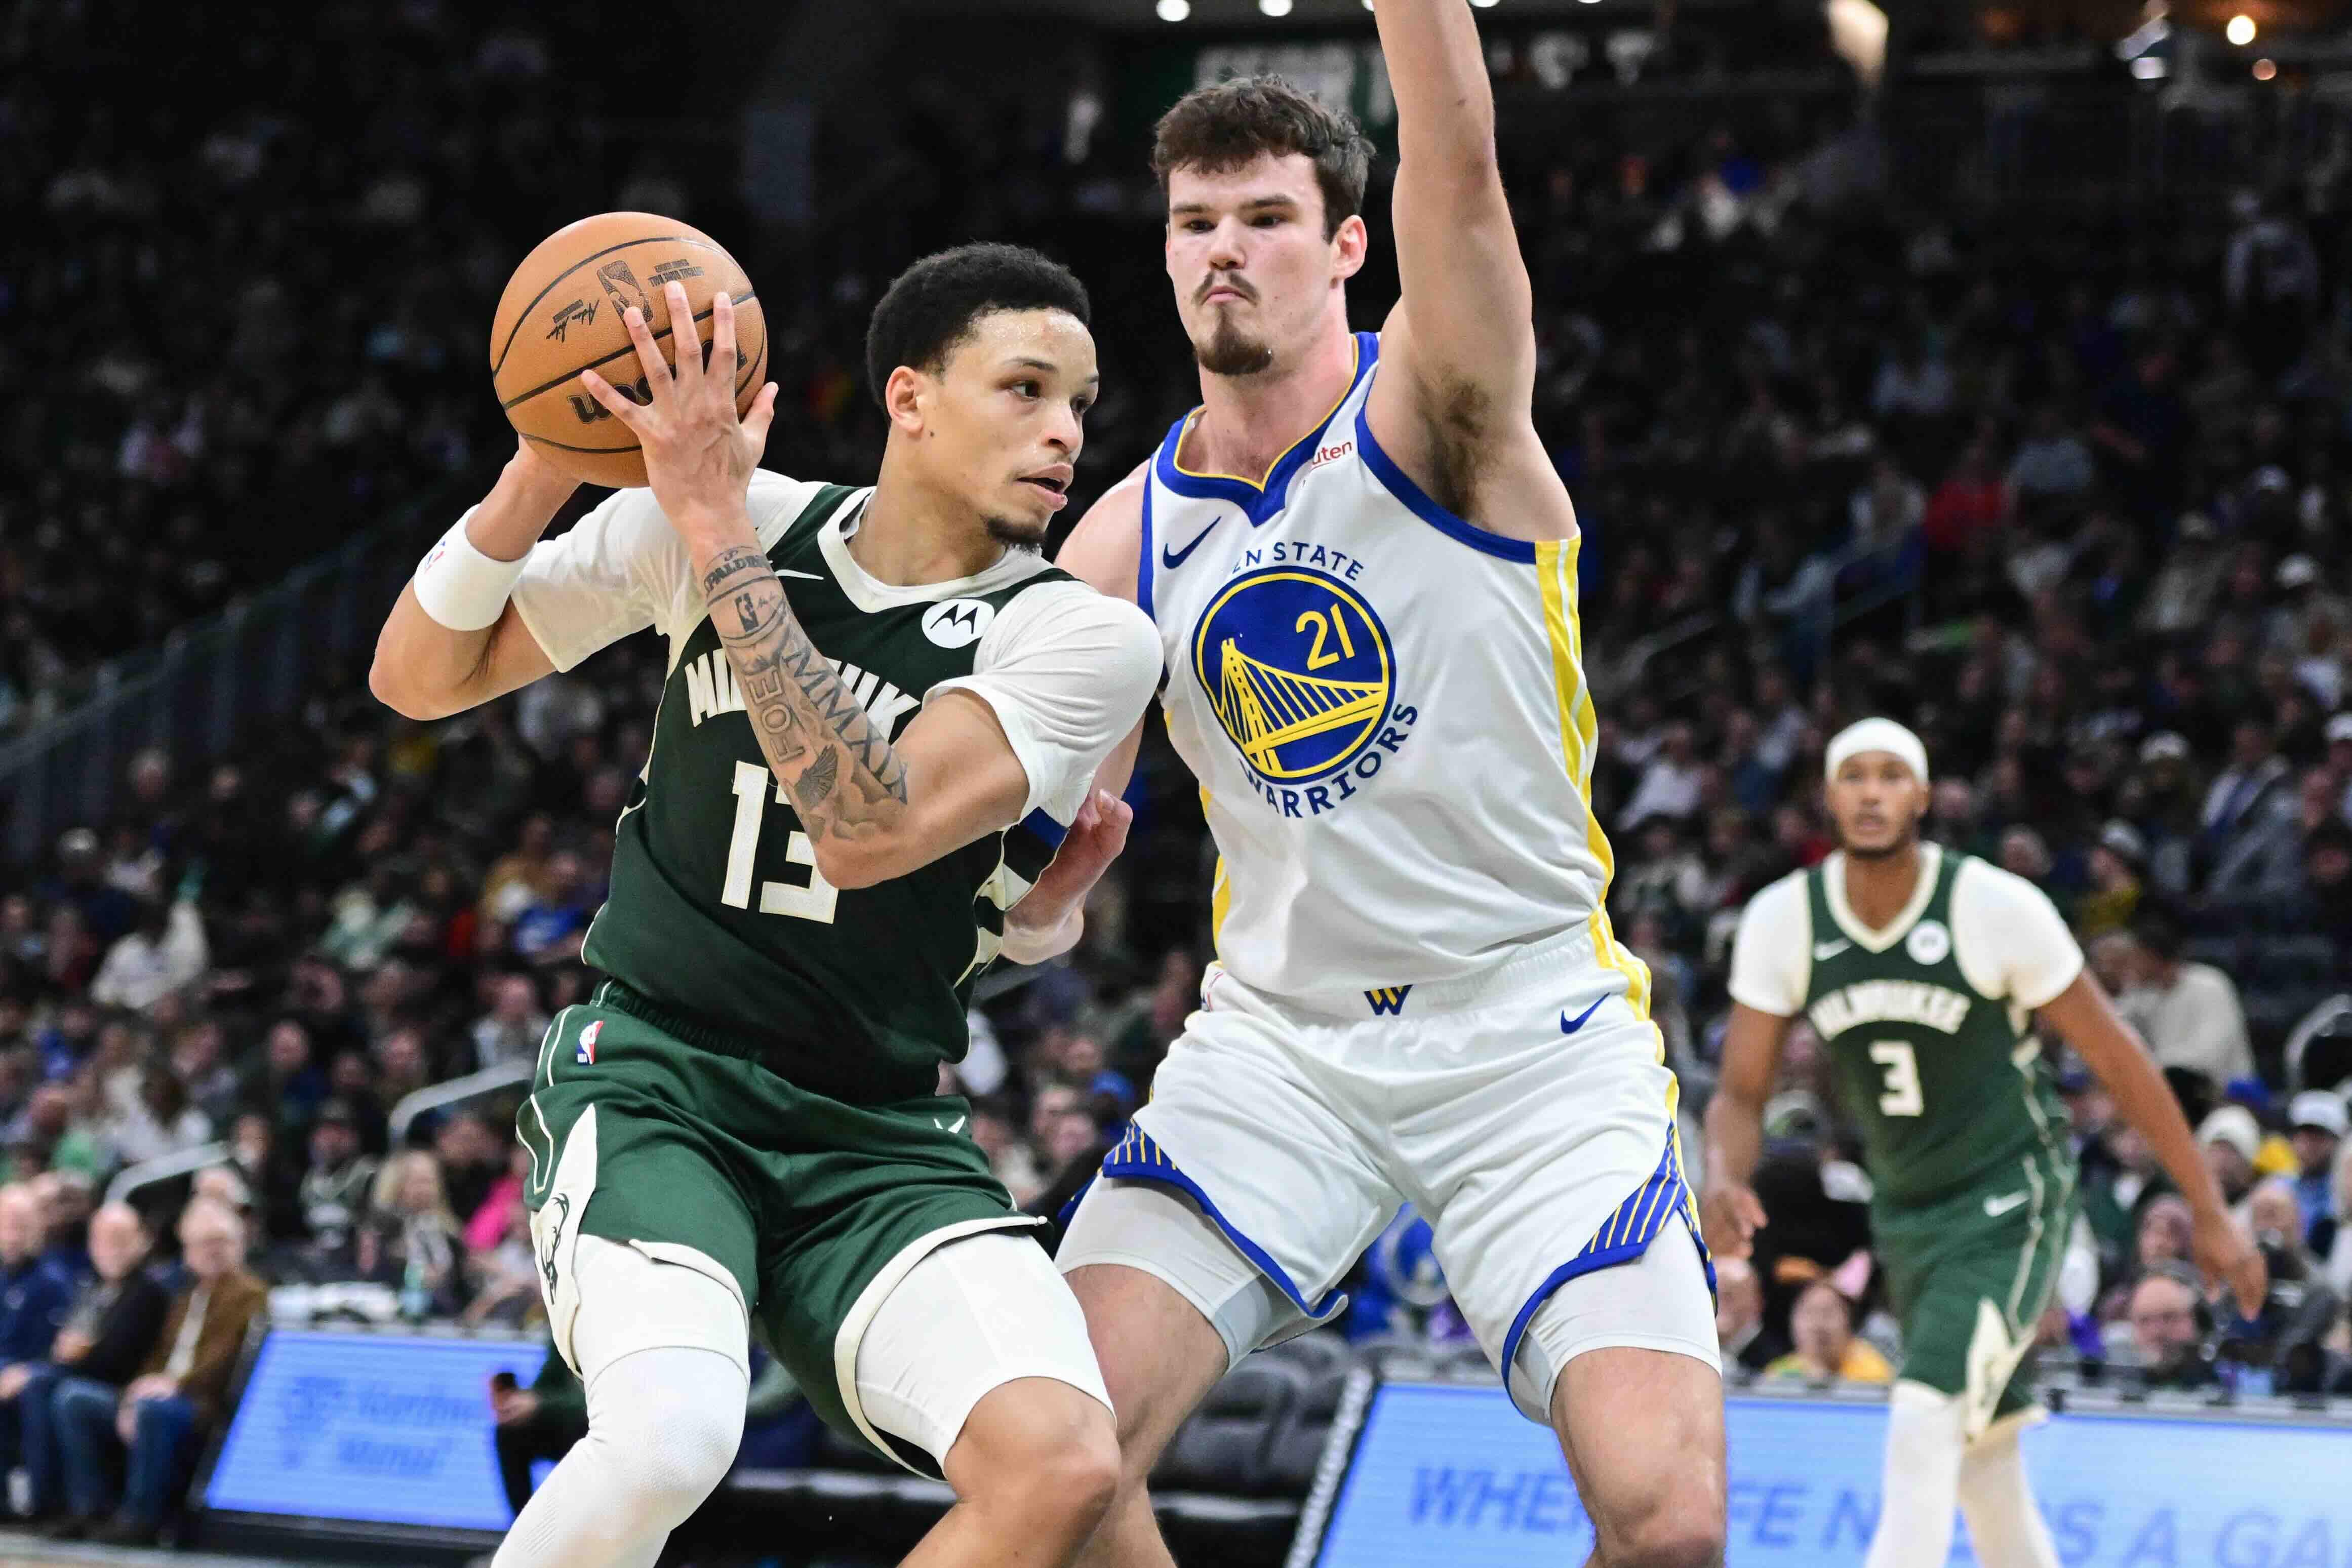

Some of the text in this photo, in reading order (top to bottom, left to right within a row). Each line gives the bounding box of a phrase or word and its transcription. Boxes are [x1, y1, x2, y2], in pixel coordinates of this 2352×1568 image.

[1312, 441, 1352, 465] uten
[1273, 541, 1364, 581] STATE
[1295, 602, 1356, 671] 21
[748, 667, 806, 763] FOE
[1239, 703, 1418, 819] WARRIORS
[721, 760, 839, 924] 13
[1364, 984, 1413, 1016] W
[1868, 1040, 1924, 1117] 3
[1410, 1466, 1582, 1535] WHE
[2212, 1504, 2352, 1568] GA
